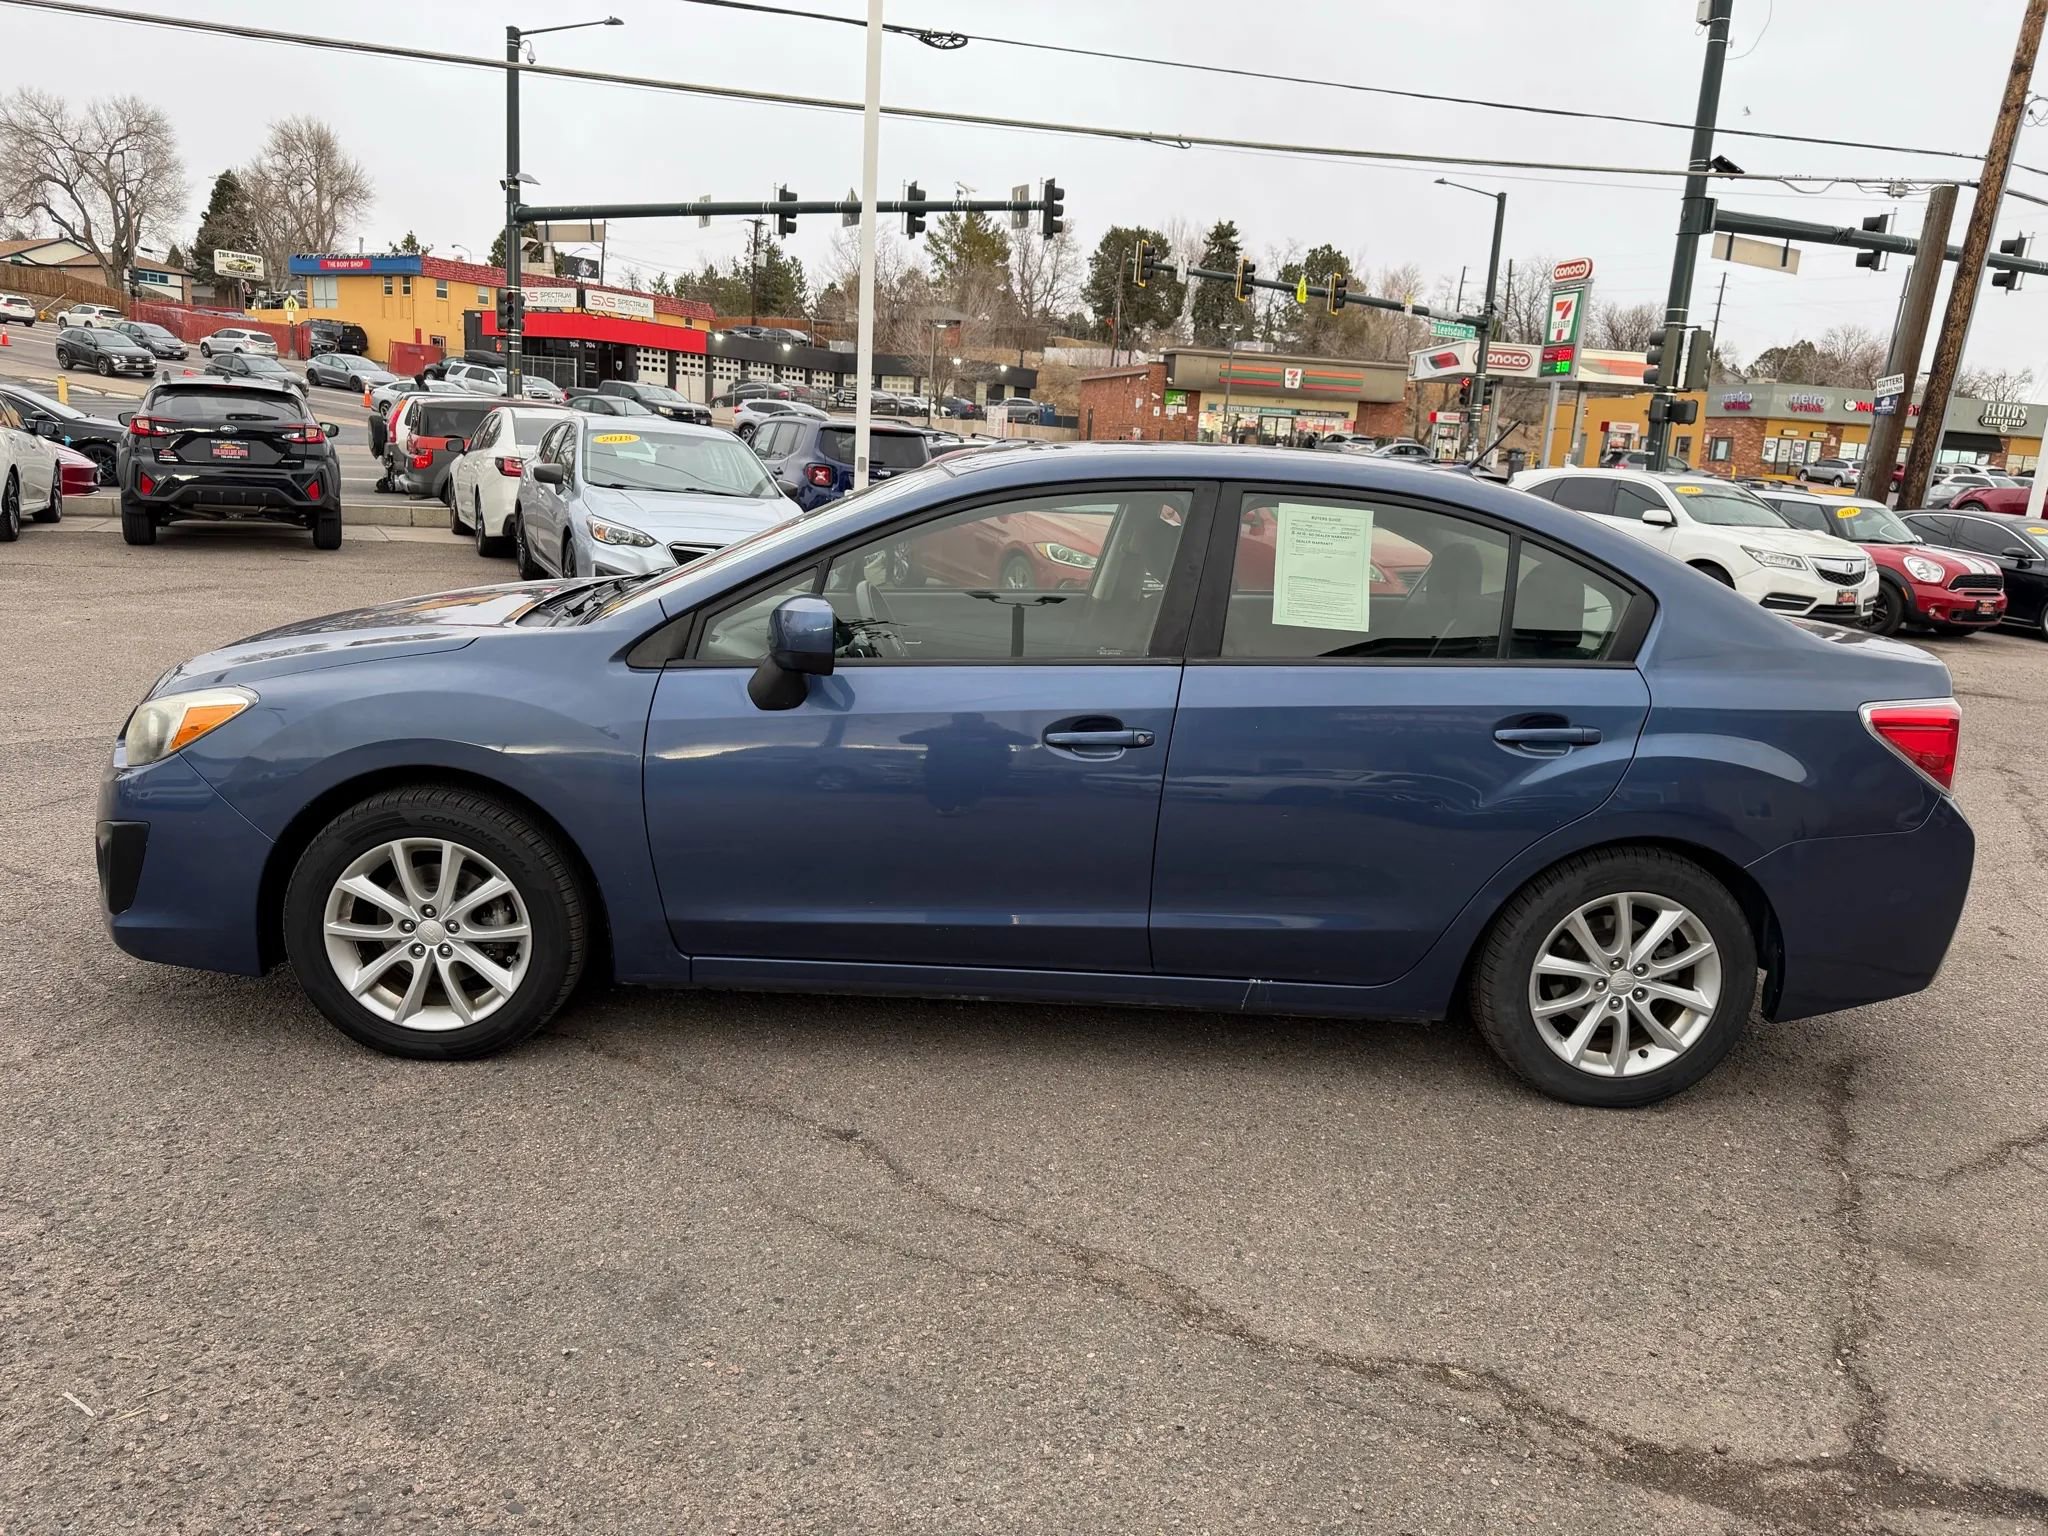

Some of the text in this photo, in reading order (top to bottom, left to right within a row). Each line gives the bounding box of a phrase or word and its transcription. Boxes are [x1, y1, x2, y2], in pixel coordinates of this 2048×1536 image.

[336, 260, 349, 268] BODY
[617, 298, 649, 308] SPECTRUM
[1437, 325, 1467, 337] Leetsdale
[585, 341, 596, 349] 704
[1877, 376, 1903, 389] GUTTERS
[1791, 393, 1826, 406] metro
[1985, 402, 2028, 419] FLOYD'S
[1984, 416, 2025, 427] BARBERSHOP
[877, 469, 891, 477] Jeep
[421, 814, 532, 874] CONTINENTAL
